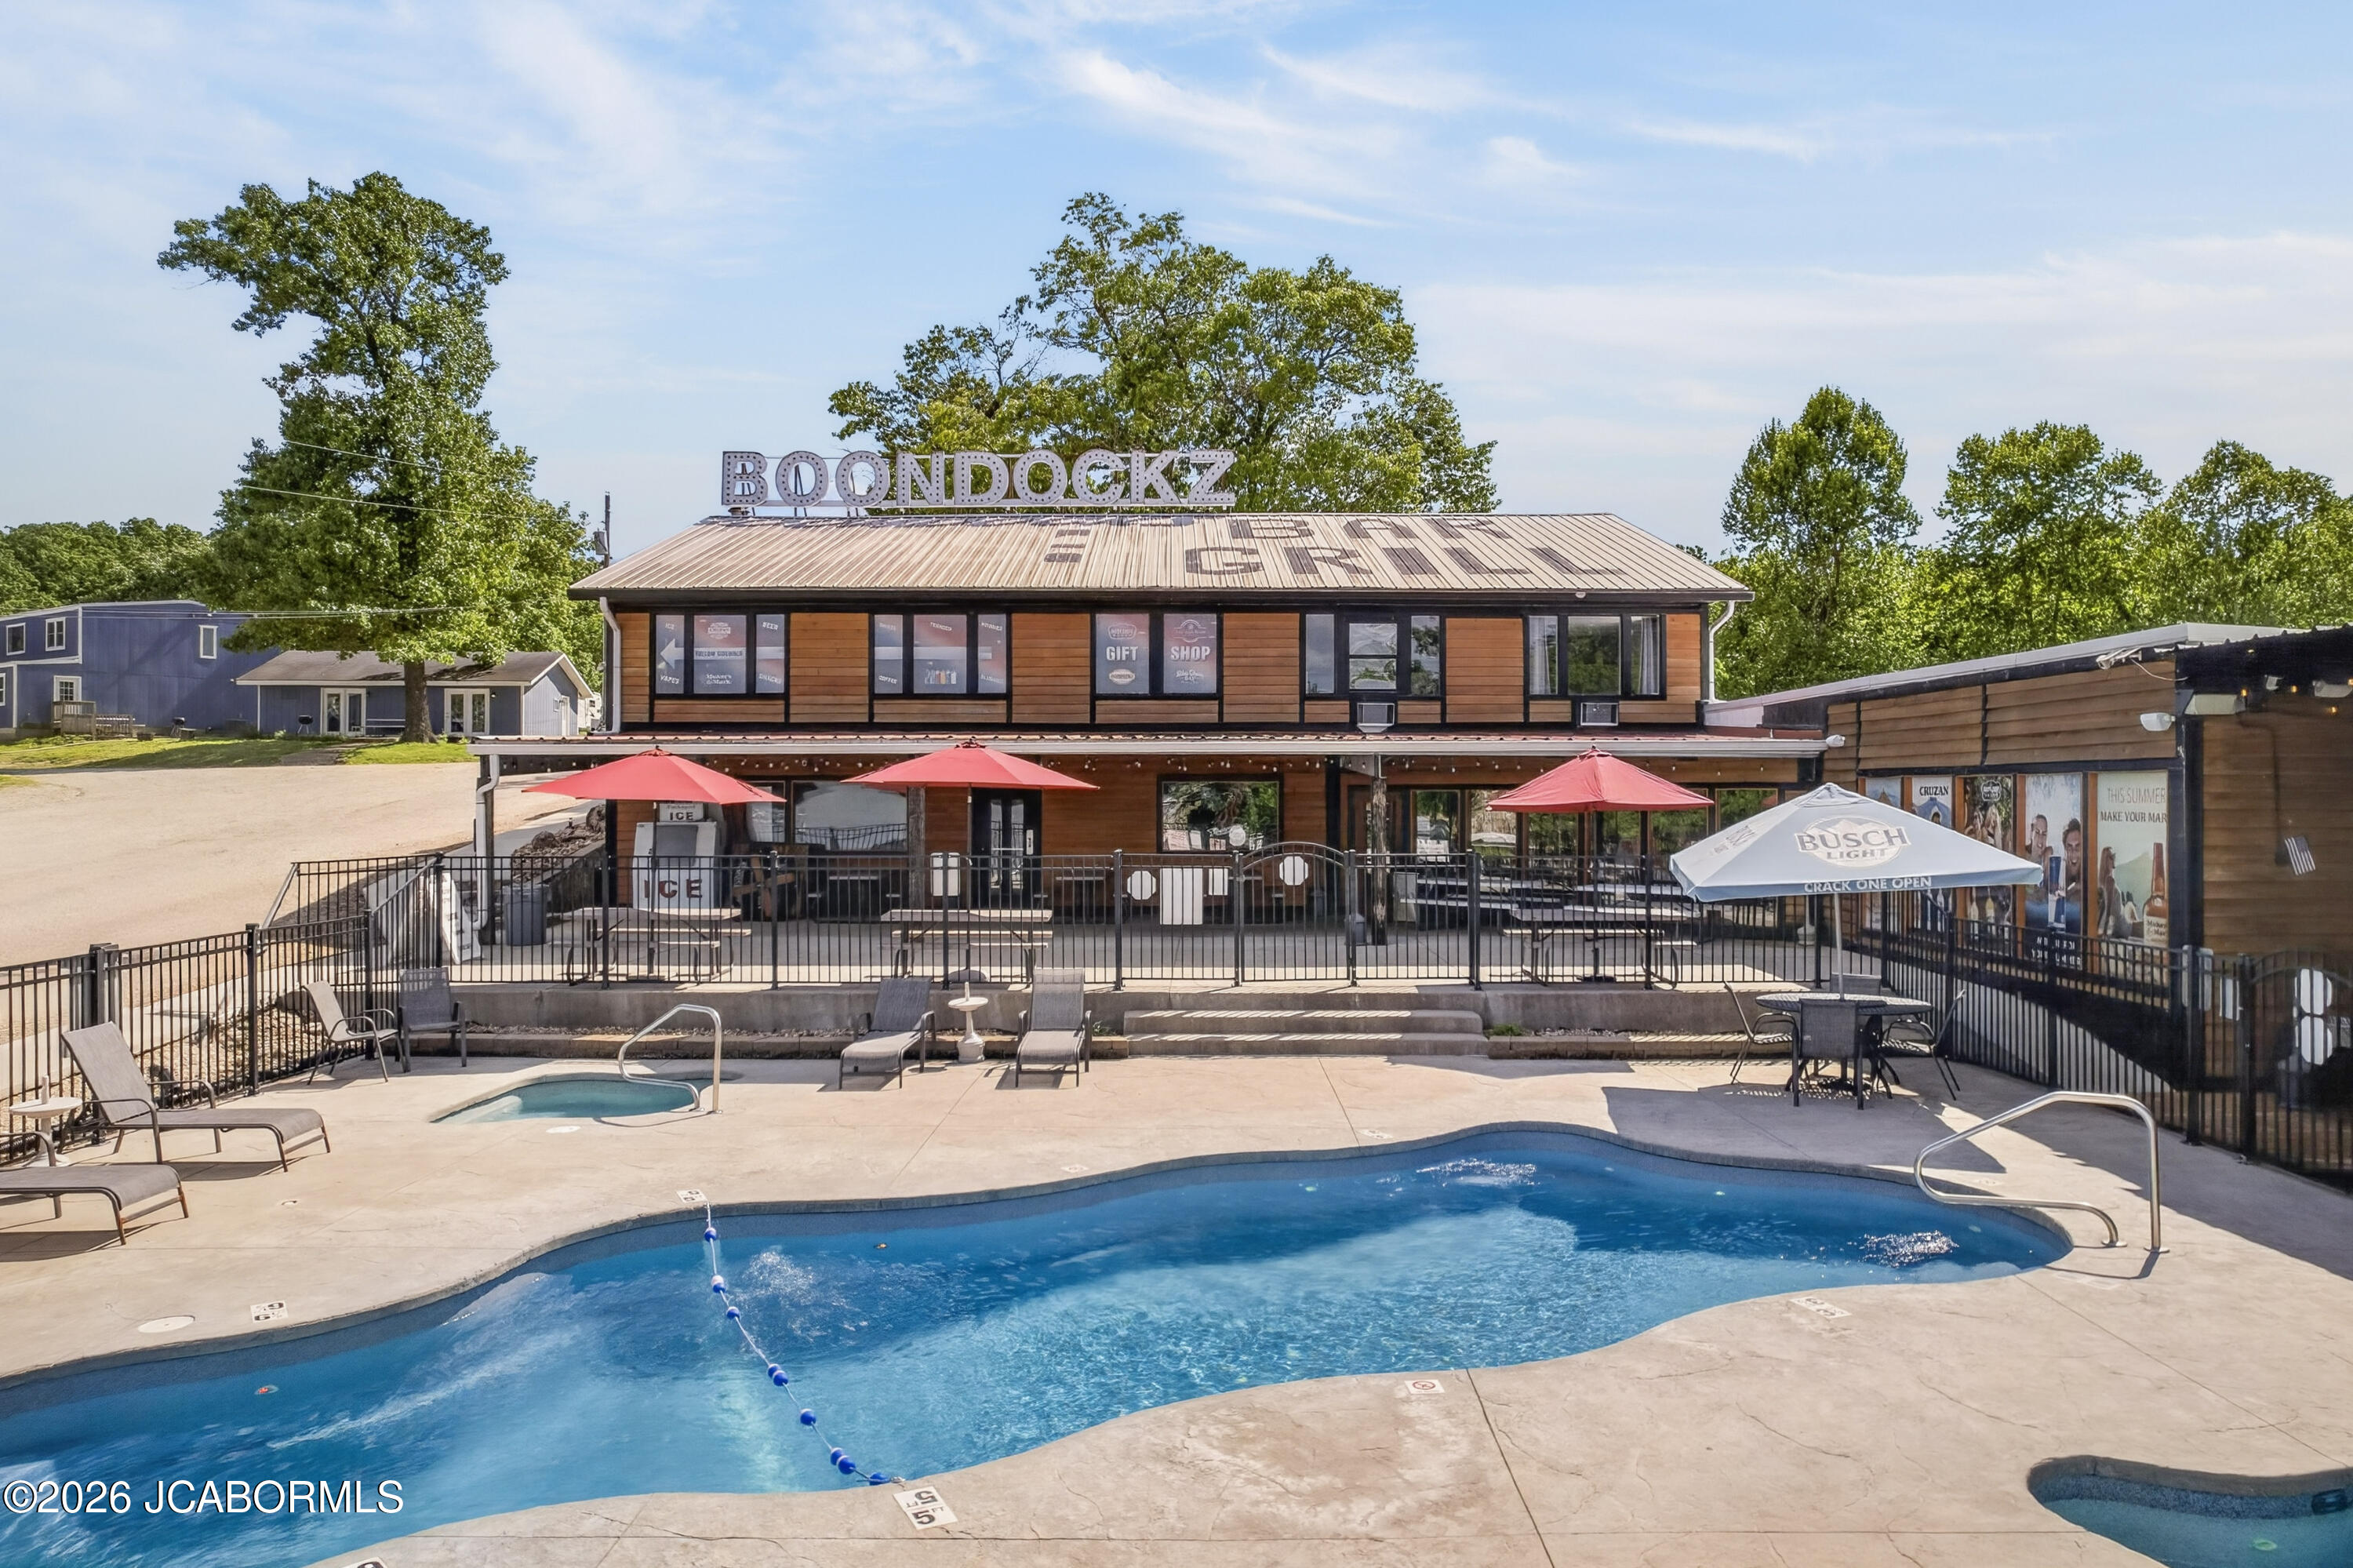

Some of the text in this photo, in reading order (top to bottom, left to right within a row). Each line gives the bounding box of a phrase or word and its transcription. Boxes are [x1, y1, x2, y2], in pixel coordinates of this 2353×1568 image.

[721, 448, 1235, 508] BOONDOCKZ
[1228, 518, 1515, 540] BAR
[1185, 546, 1626, 576] GRILL
[1106, 646, 1139, 661] GIFT
[1170, 646, 1211, 661] SHOP
[1919, 786, 1949, 797] CRUZAN
[2107, 787, 2166, 804] THIS SUMMER
[669, 811, 693, 821] ICE
[2101, 810, 2122, 823] MAKE
[2125, 810, 2146, 823] YOUR
[1795, 828, 1908, 852] BUSCH
[1826, 847, 1889, 860] LIGHT
[644, 879, 702, 899] ICE
[1804, 876, 1933, 893] CRACK ONE OPEN
[915, 1490, 938, 1504] 5
[912, 1510, 935, 1525] 5
